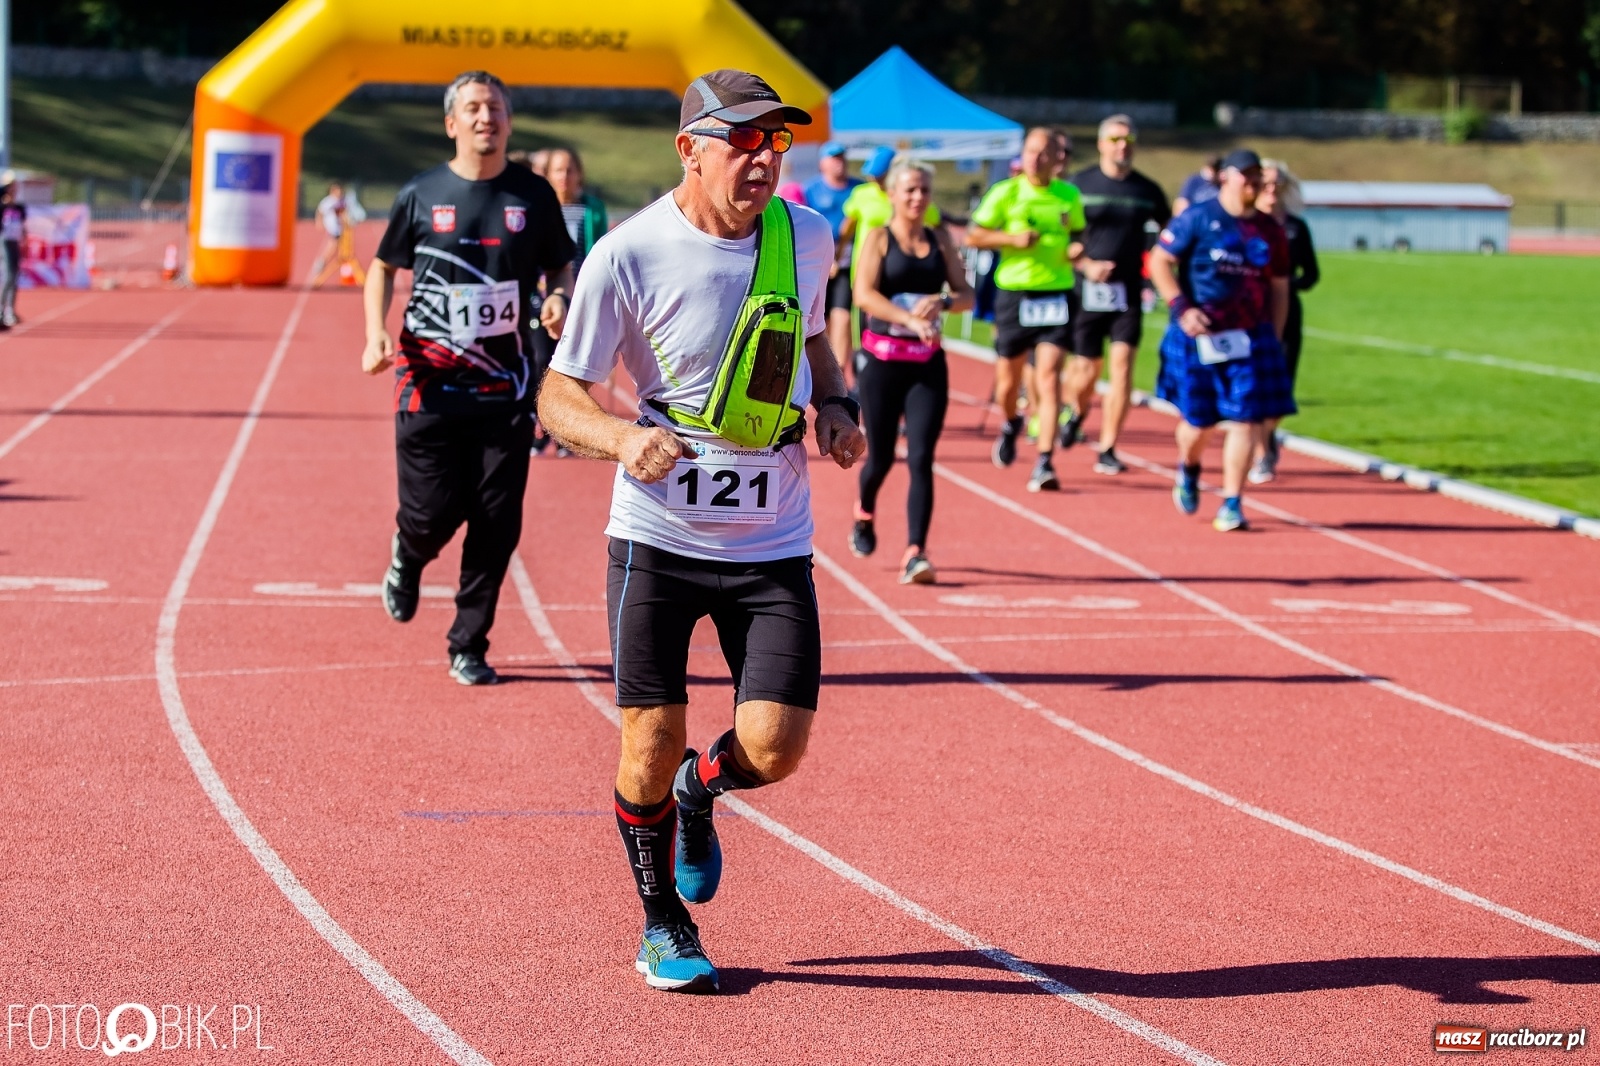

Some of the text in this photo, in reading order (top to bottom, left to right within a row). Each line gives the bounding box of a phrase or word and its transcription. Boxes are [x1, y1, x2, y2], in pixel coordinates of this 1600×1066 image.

[402, 26, 628, 51] MIASTO RACIBÓRZ
[457, 301, 516, 327] 194
[710, 448, 776, 458] www.personalbest.pl
[677, 468, 769, 508] 121
